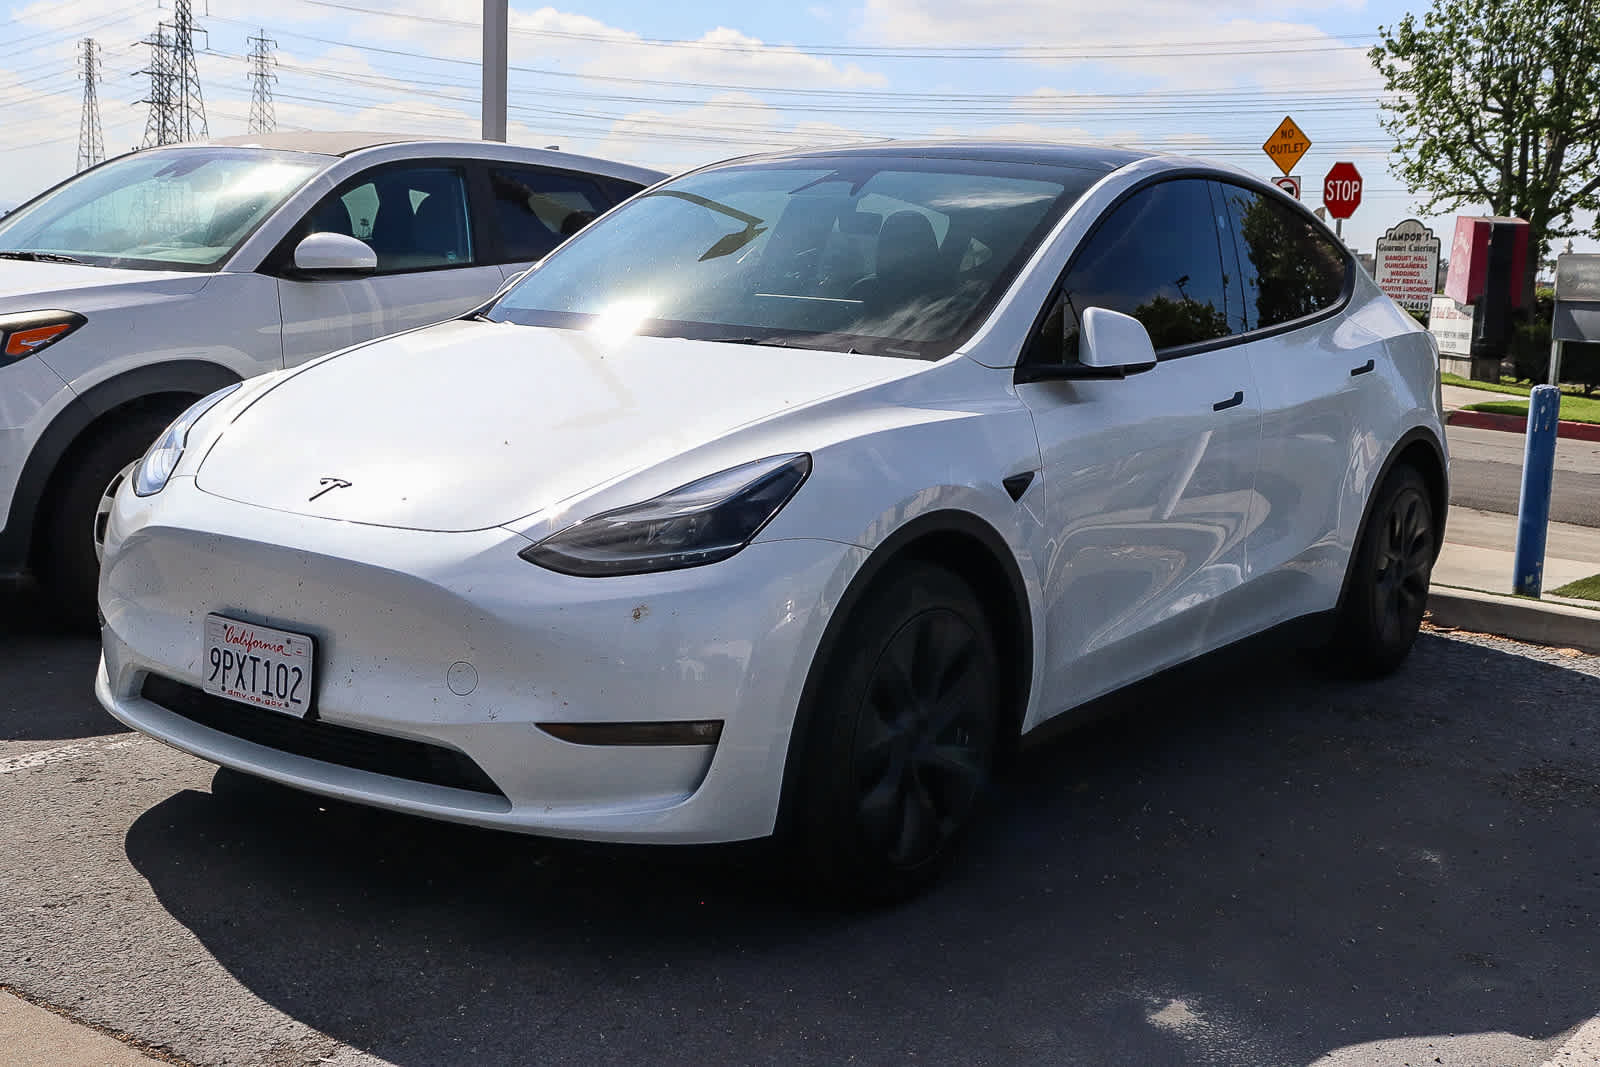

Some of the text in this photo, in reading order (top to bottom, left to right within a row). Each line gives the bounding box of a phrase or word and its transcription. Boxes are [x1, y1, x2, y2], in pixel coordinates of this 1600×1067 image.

[1280, 129, 1294, 139] NO
[1270, 142, 1304, 154] OUTLET
[1326, 180, 1360, 201] STOP
[1379, 243, 1437, 253] Gourmet Catering
[225, 625, 292, 656] California
[208, 647, 303, 704] 9PXT102
[227, 689, 283, 708] dmv.ca.gov
